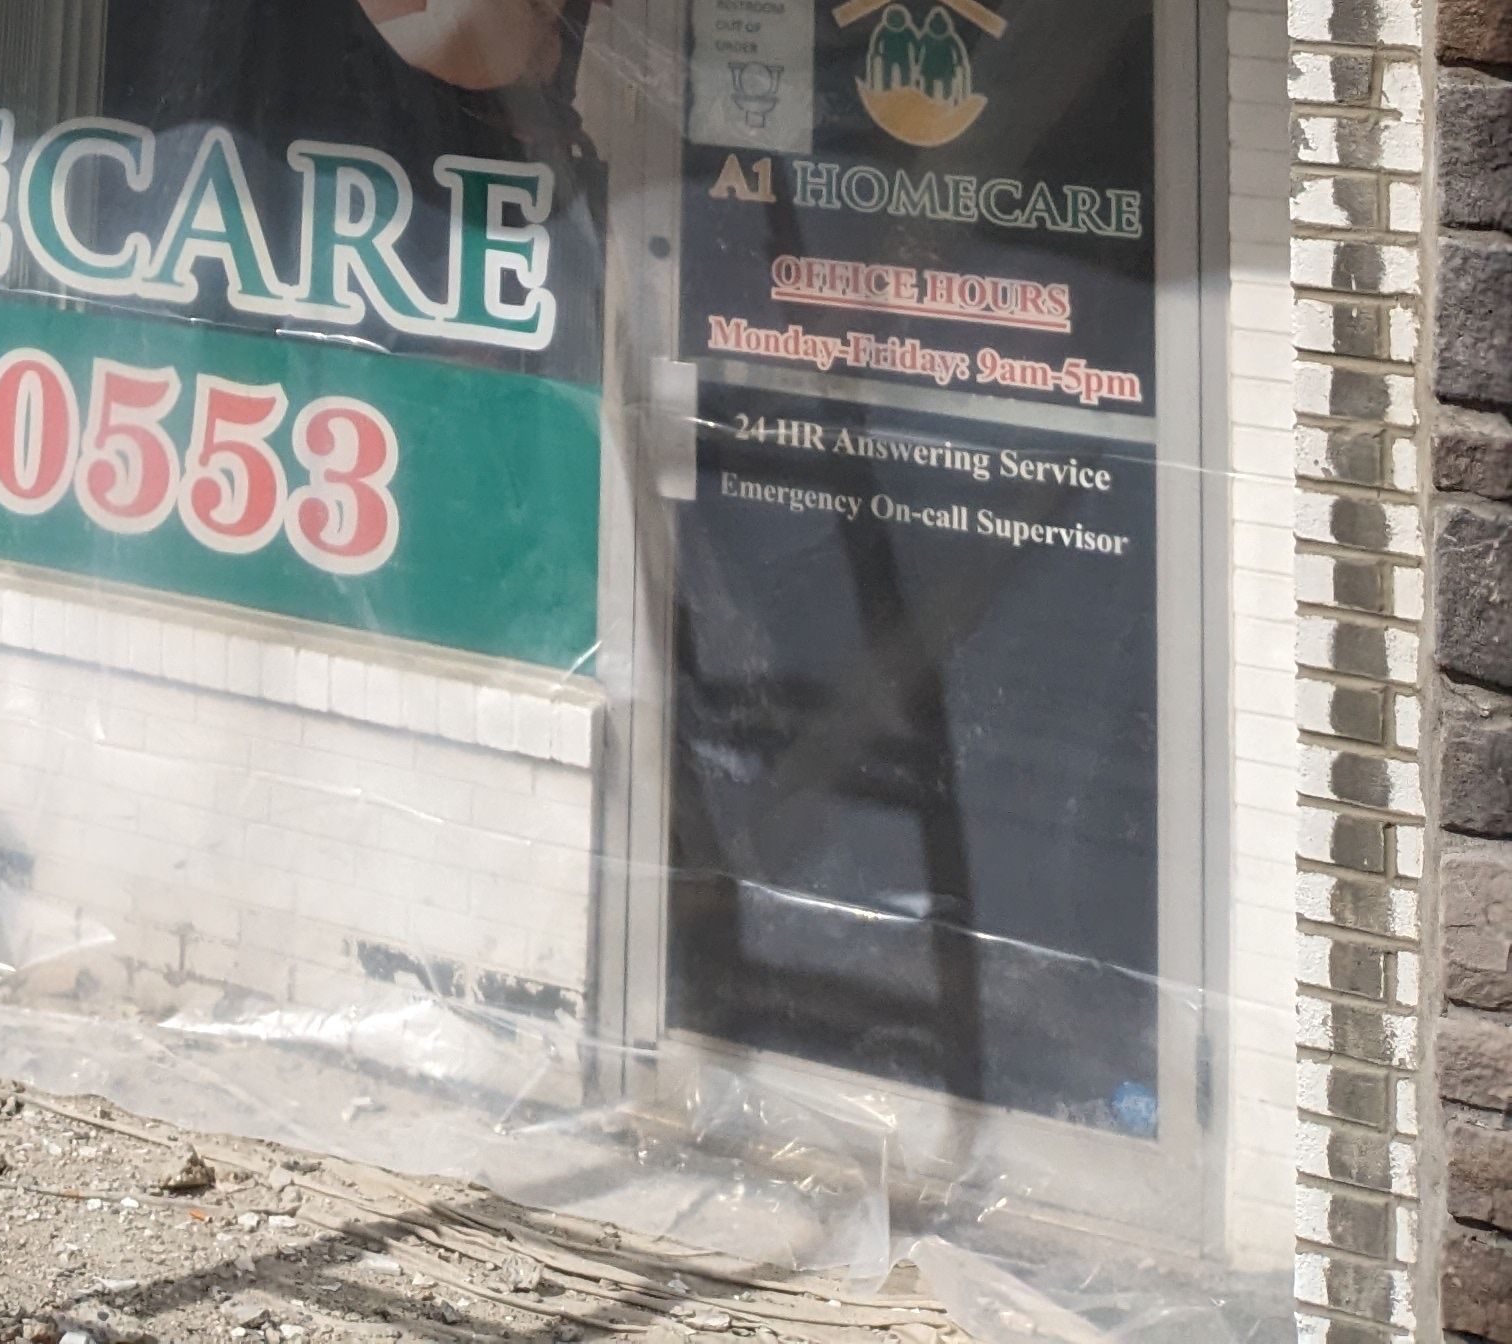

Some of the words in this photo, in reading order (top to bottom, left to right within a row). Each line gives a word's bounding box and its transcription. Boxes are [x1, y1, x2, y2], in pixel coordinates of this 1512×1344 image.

[708, 153, 776, 204] A1
[792, 160, 1143, 239] HOMECARE
[772, 254, 918, 301] OFFICE
[926, 269, 1071, 318] HOURS
[708, 315, 971, 385] Monday-Friday:
[977, 349, 1143, 405] 9am-5pm
[735, 413, 765, 443] 24
[775, 417, 826, 453] HR
[832, 426, 991, 480] Answering
[999, 448, 1113, 492] Service
[720, 471, 863, 521] Emergency
[870, 492, 969, 532] On-call
[977, 509, 1130, 555] Supervisor
